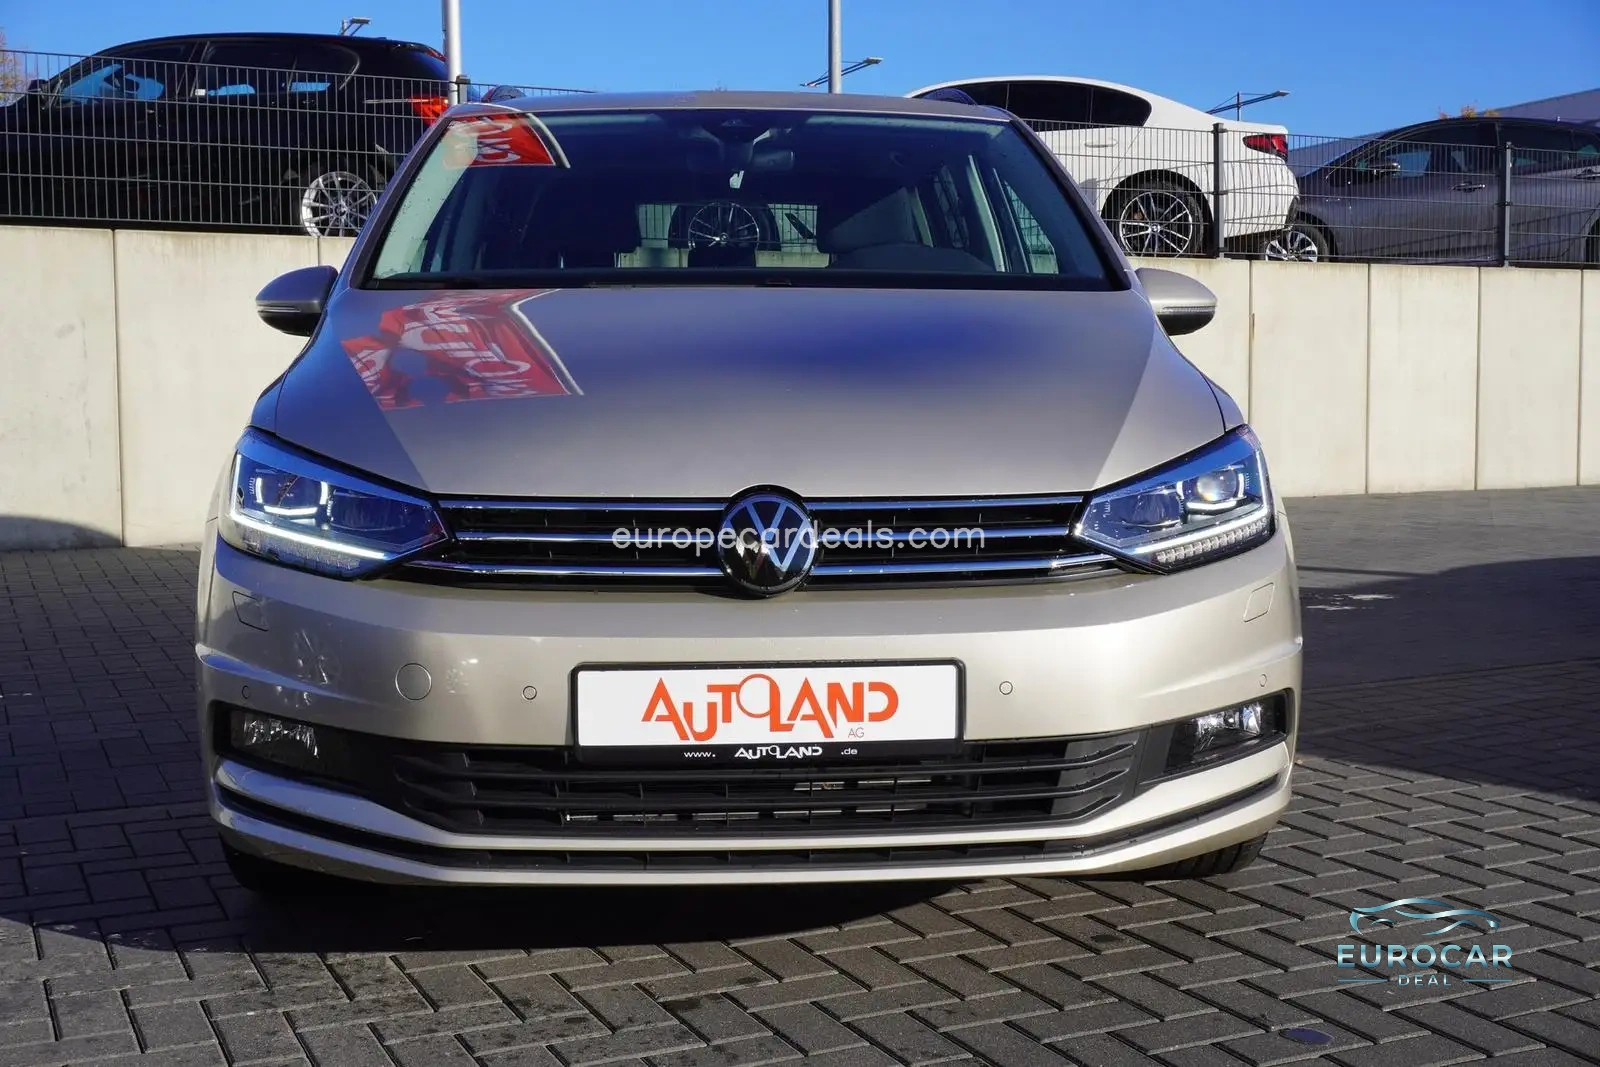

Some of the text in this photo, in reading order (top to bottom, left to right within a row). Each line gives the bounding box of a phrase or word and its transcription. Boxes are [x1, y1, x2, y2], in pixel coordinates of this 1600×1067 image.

[641, 673, 899, 742] AUTOLAND
[847, 726, 866, 739] AG
[734, 744, 823, 760] AUTOLAND
[840, 747, 858, 756] .de
